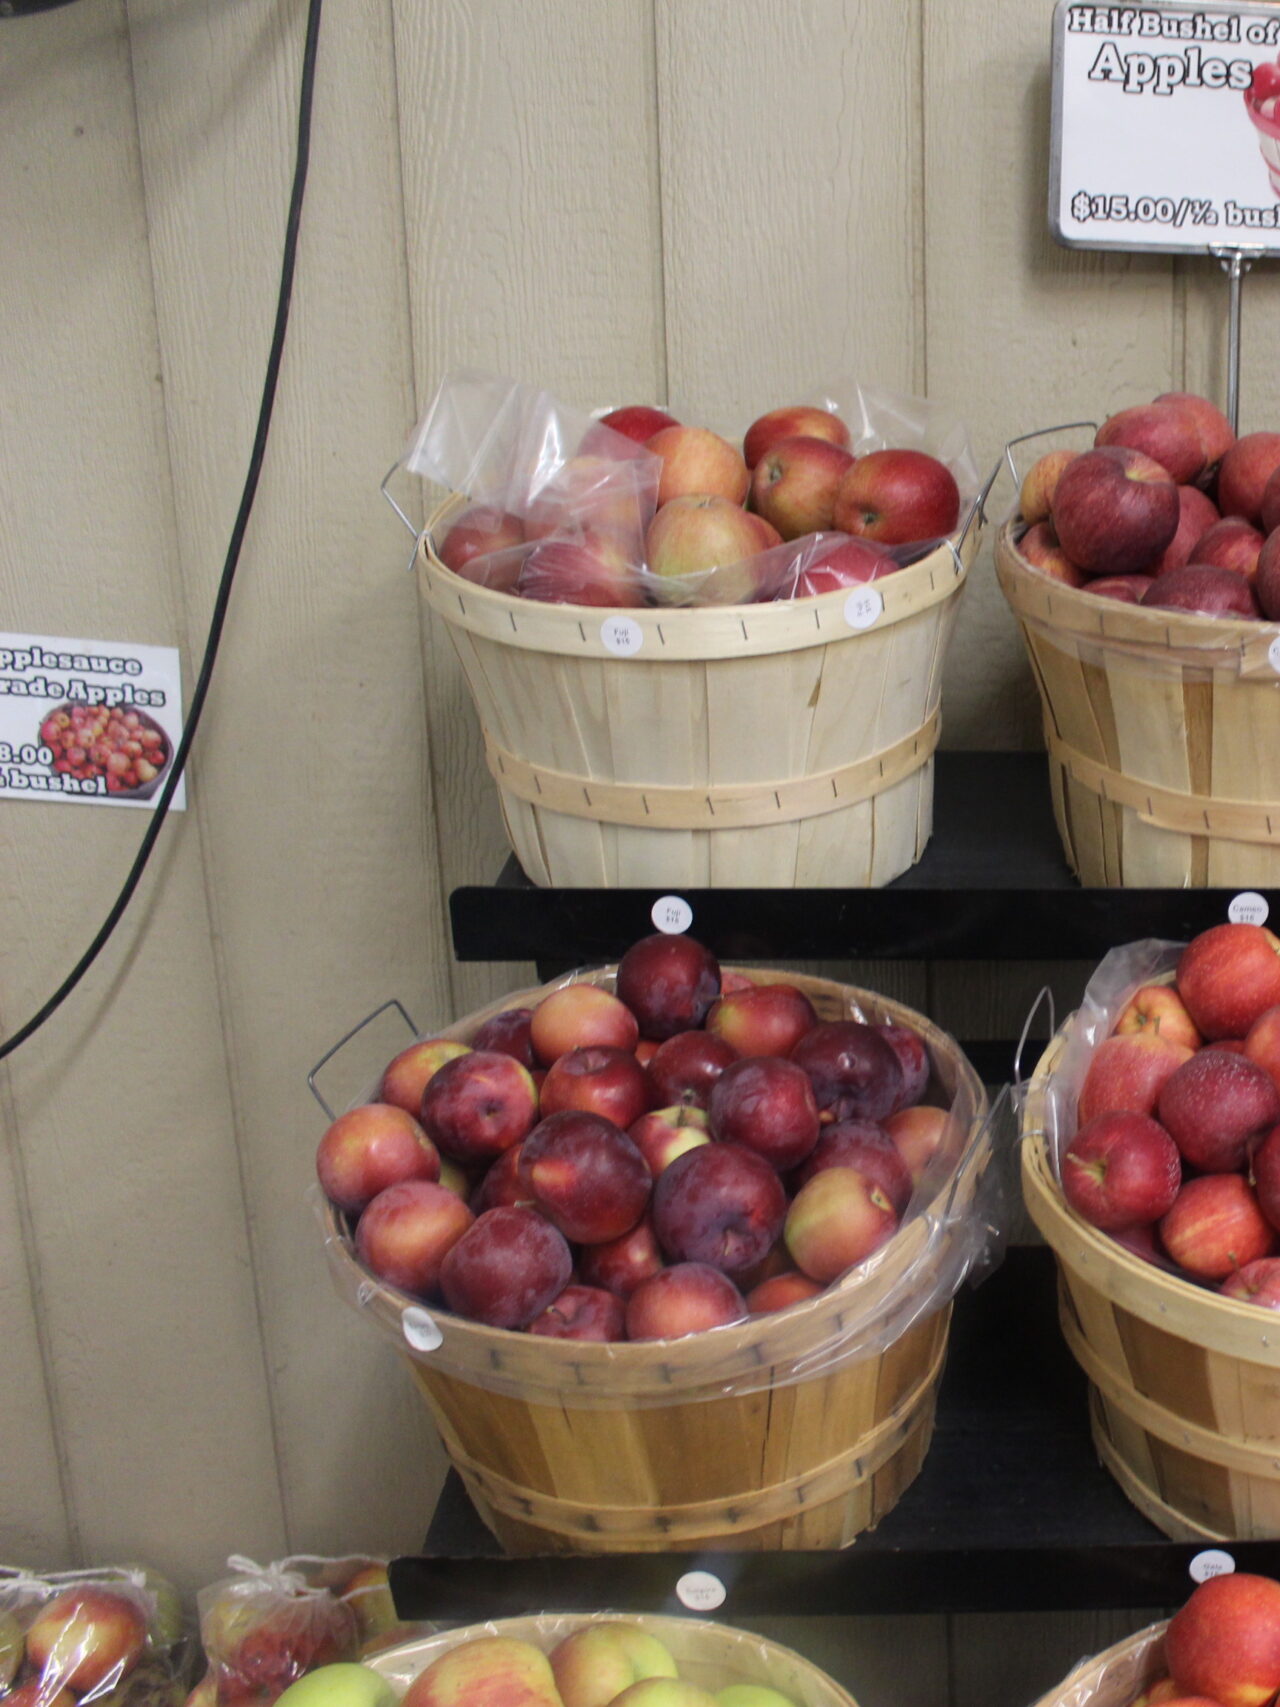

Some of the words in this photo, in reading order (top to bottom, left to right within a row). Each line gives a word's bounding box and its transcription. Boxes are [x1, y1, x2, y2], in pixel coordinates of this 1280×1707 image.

[1068, 6, 1140, 35] Half
[1139, 11, 1241, 43] Bushel
[1088, 42, 1253, 95] Apples
[67, 679, 166, 706] Apples
[8, 768, 108, 795] bushel
